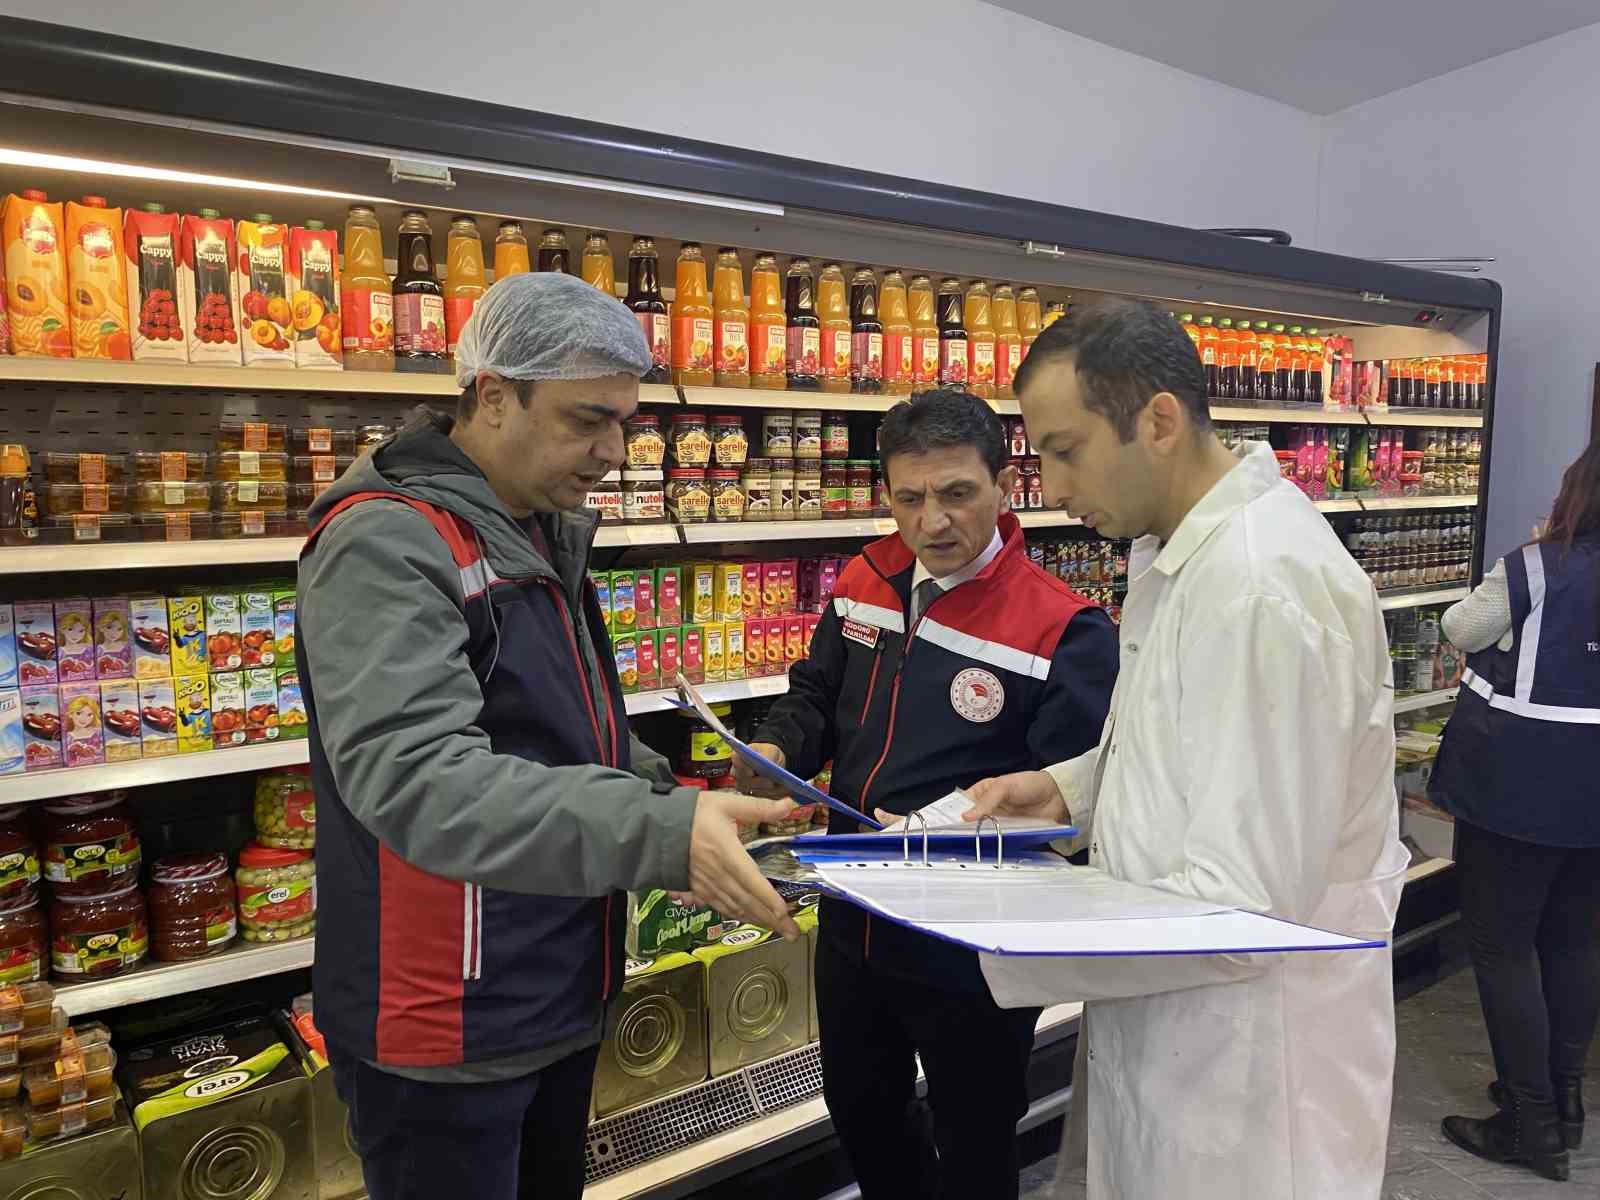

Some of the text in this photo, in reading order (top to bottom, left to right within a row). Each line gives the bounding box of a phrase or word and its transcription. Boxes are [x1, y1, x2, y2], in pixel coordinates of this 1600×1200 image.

[140, 244, 173, 258] Cappy
[196, 249, 226, 263] Cappy
[251, 255, 280, 267] Cappy
[303, 260, 330, 272] Cappy
[271, 888, 287, 899] erel
[727, 932, 757, 945] erel
[197, 1076, 241, 1095] erel
